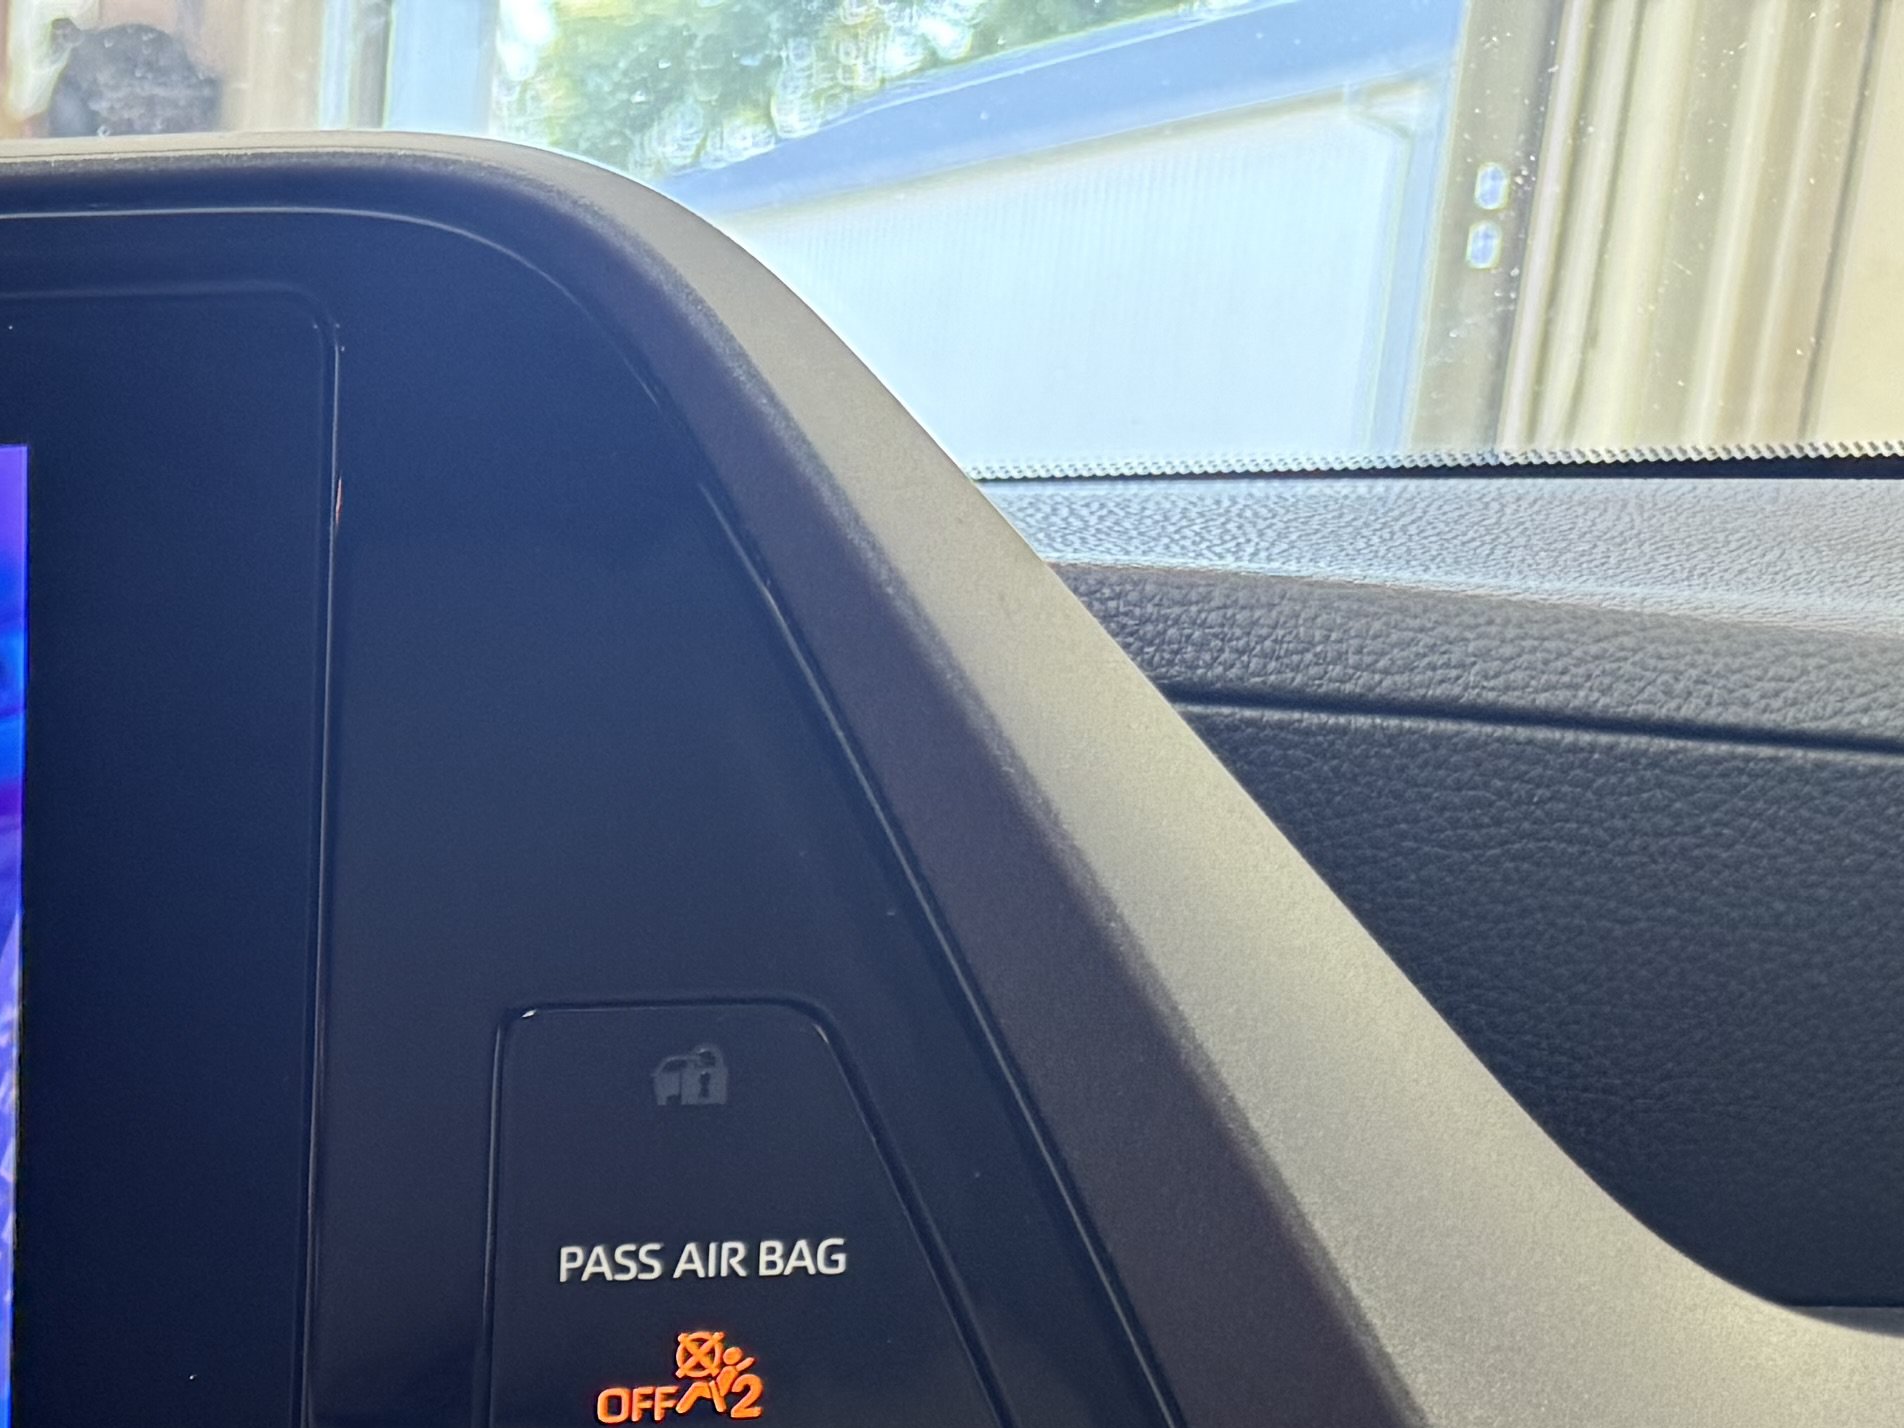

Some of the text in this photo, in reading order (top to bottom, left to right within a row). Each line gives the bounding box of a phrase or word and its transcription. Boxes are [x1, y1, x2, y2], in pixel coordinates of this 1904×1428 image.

[559, 1237, 848, 1283] PASS AIR BAG
[596, 1384, 679, 1425] OFF
